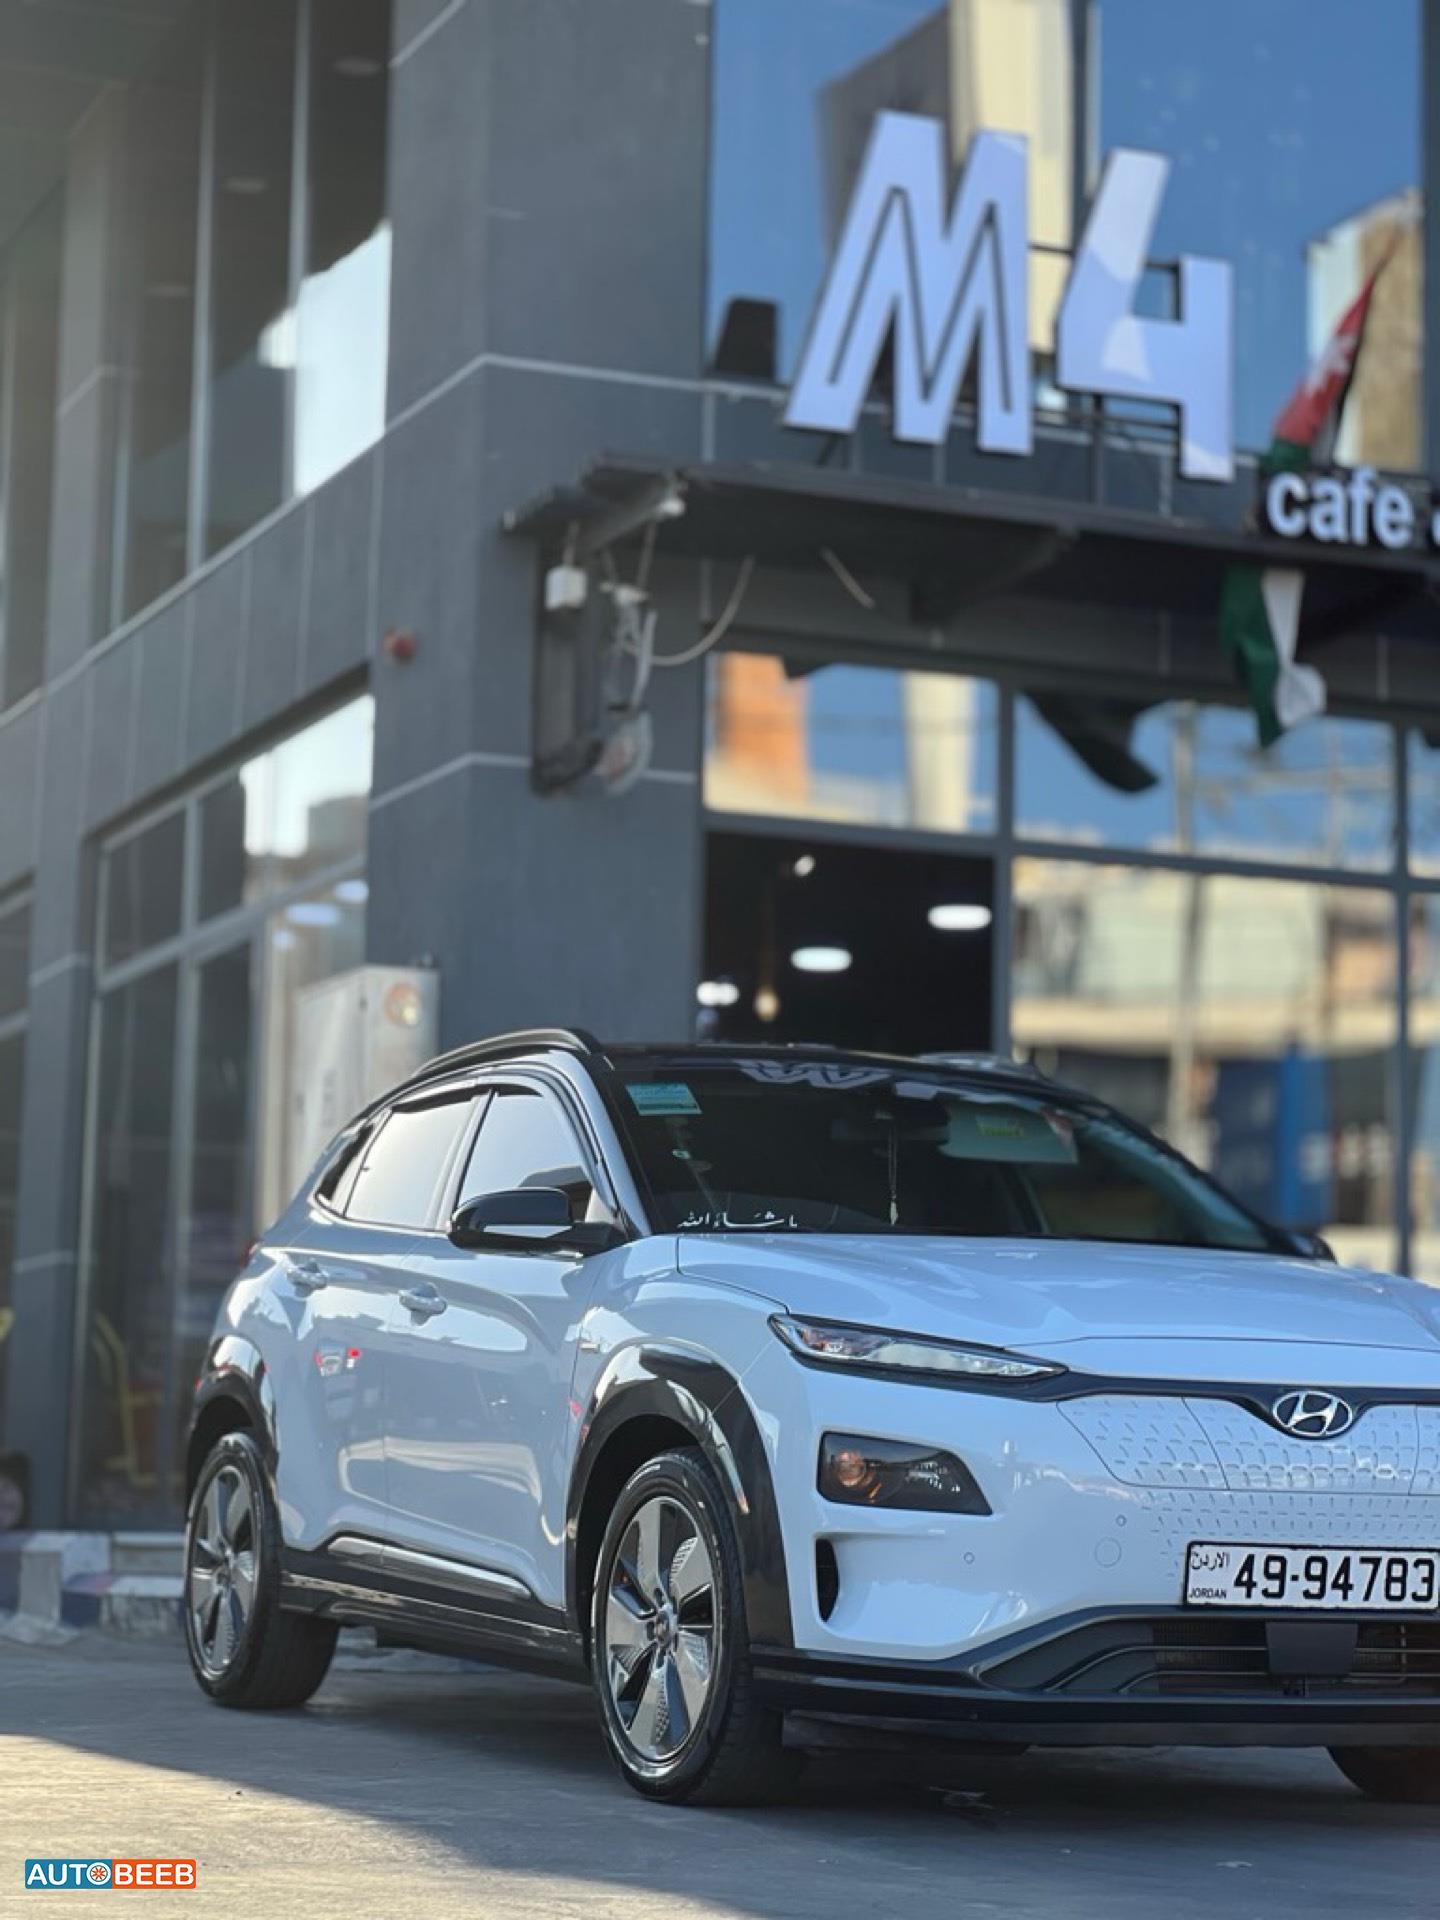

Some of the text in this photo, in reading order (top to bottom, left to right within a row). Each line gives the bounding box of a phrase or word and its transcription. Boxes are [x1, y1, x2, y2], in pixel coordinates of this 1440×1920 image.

[783, 109, 1235, 482] M4
[1266, 466, 1414, 548] cafe
[1189, 1587, 1227, 1599] JORDAN
[1233, 1553, 1435, 1602] 49-94783
